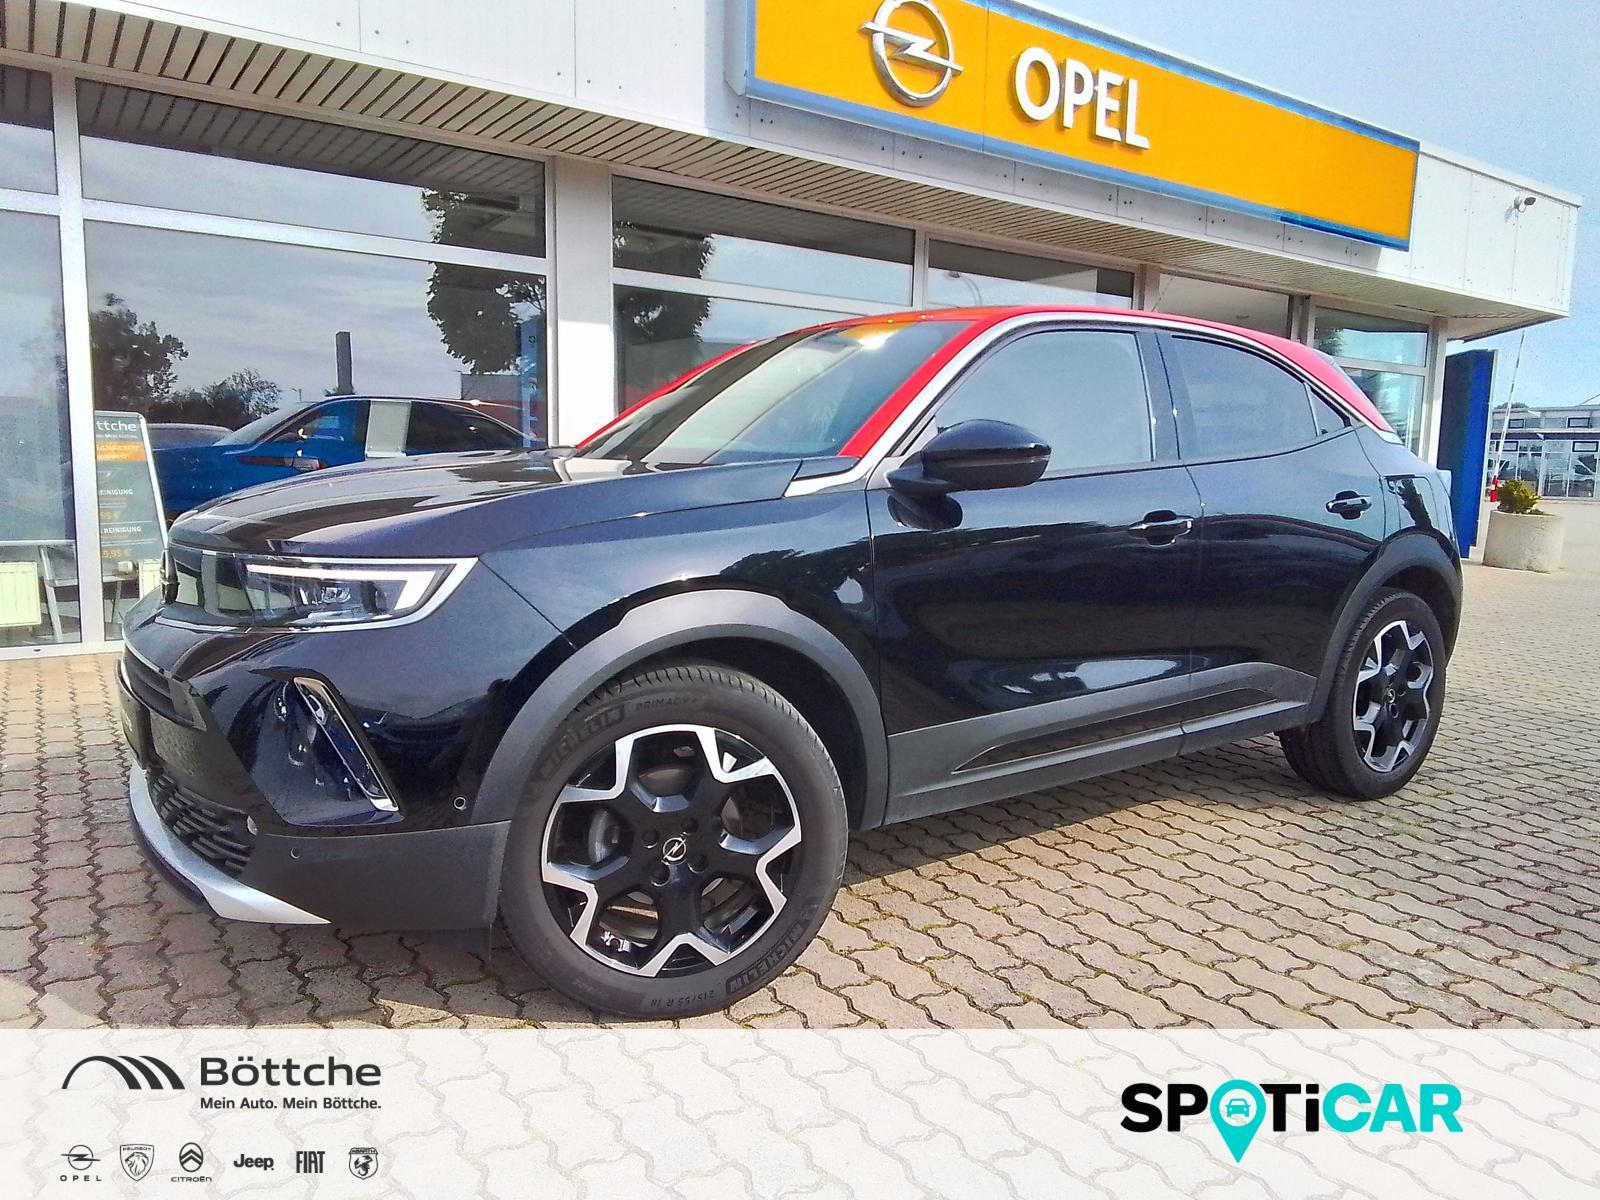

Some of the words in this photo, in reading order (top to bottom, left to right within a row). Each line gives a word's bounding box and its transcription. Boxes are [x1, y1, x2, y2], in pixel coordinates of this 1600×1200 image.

[1014, 46, 1150, 150] OPEL
[95, 420, 137, 431] ttche
[99, 488, 134, 496] EINIGUNG
[729, 920, 805, 994] MICHELIN
